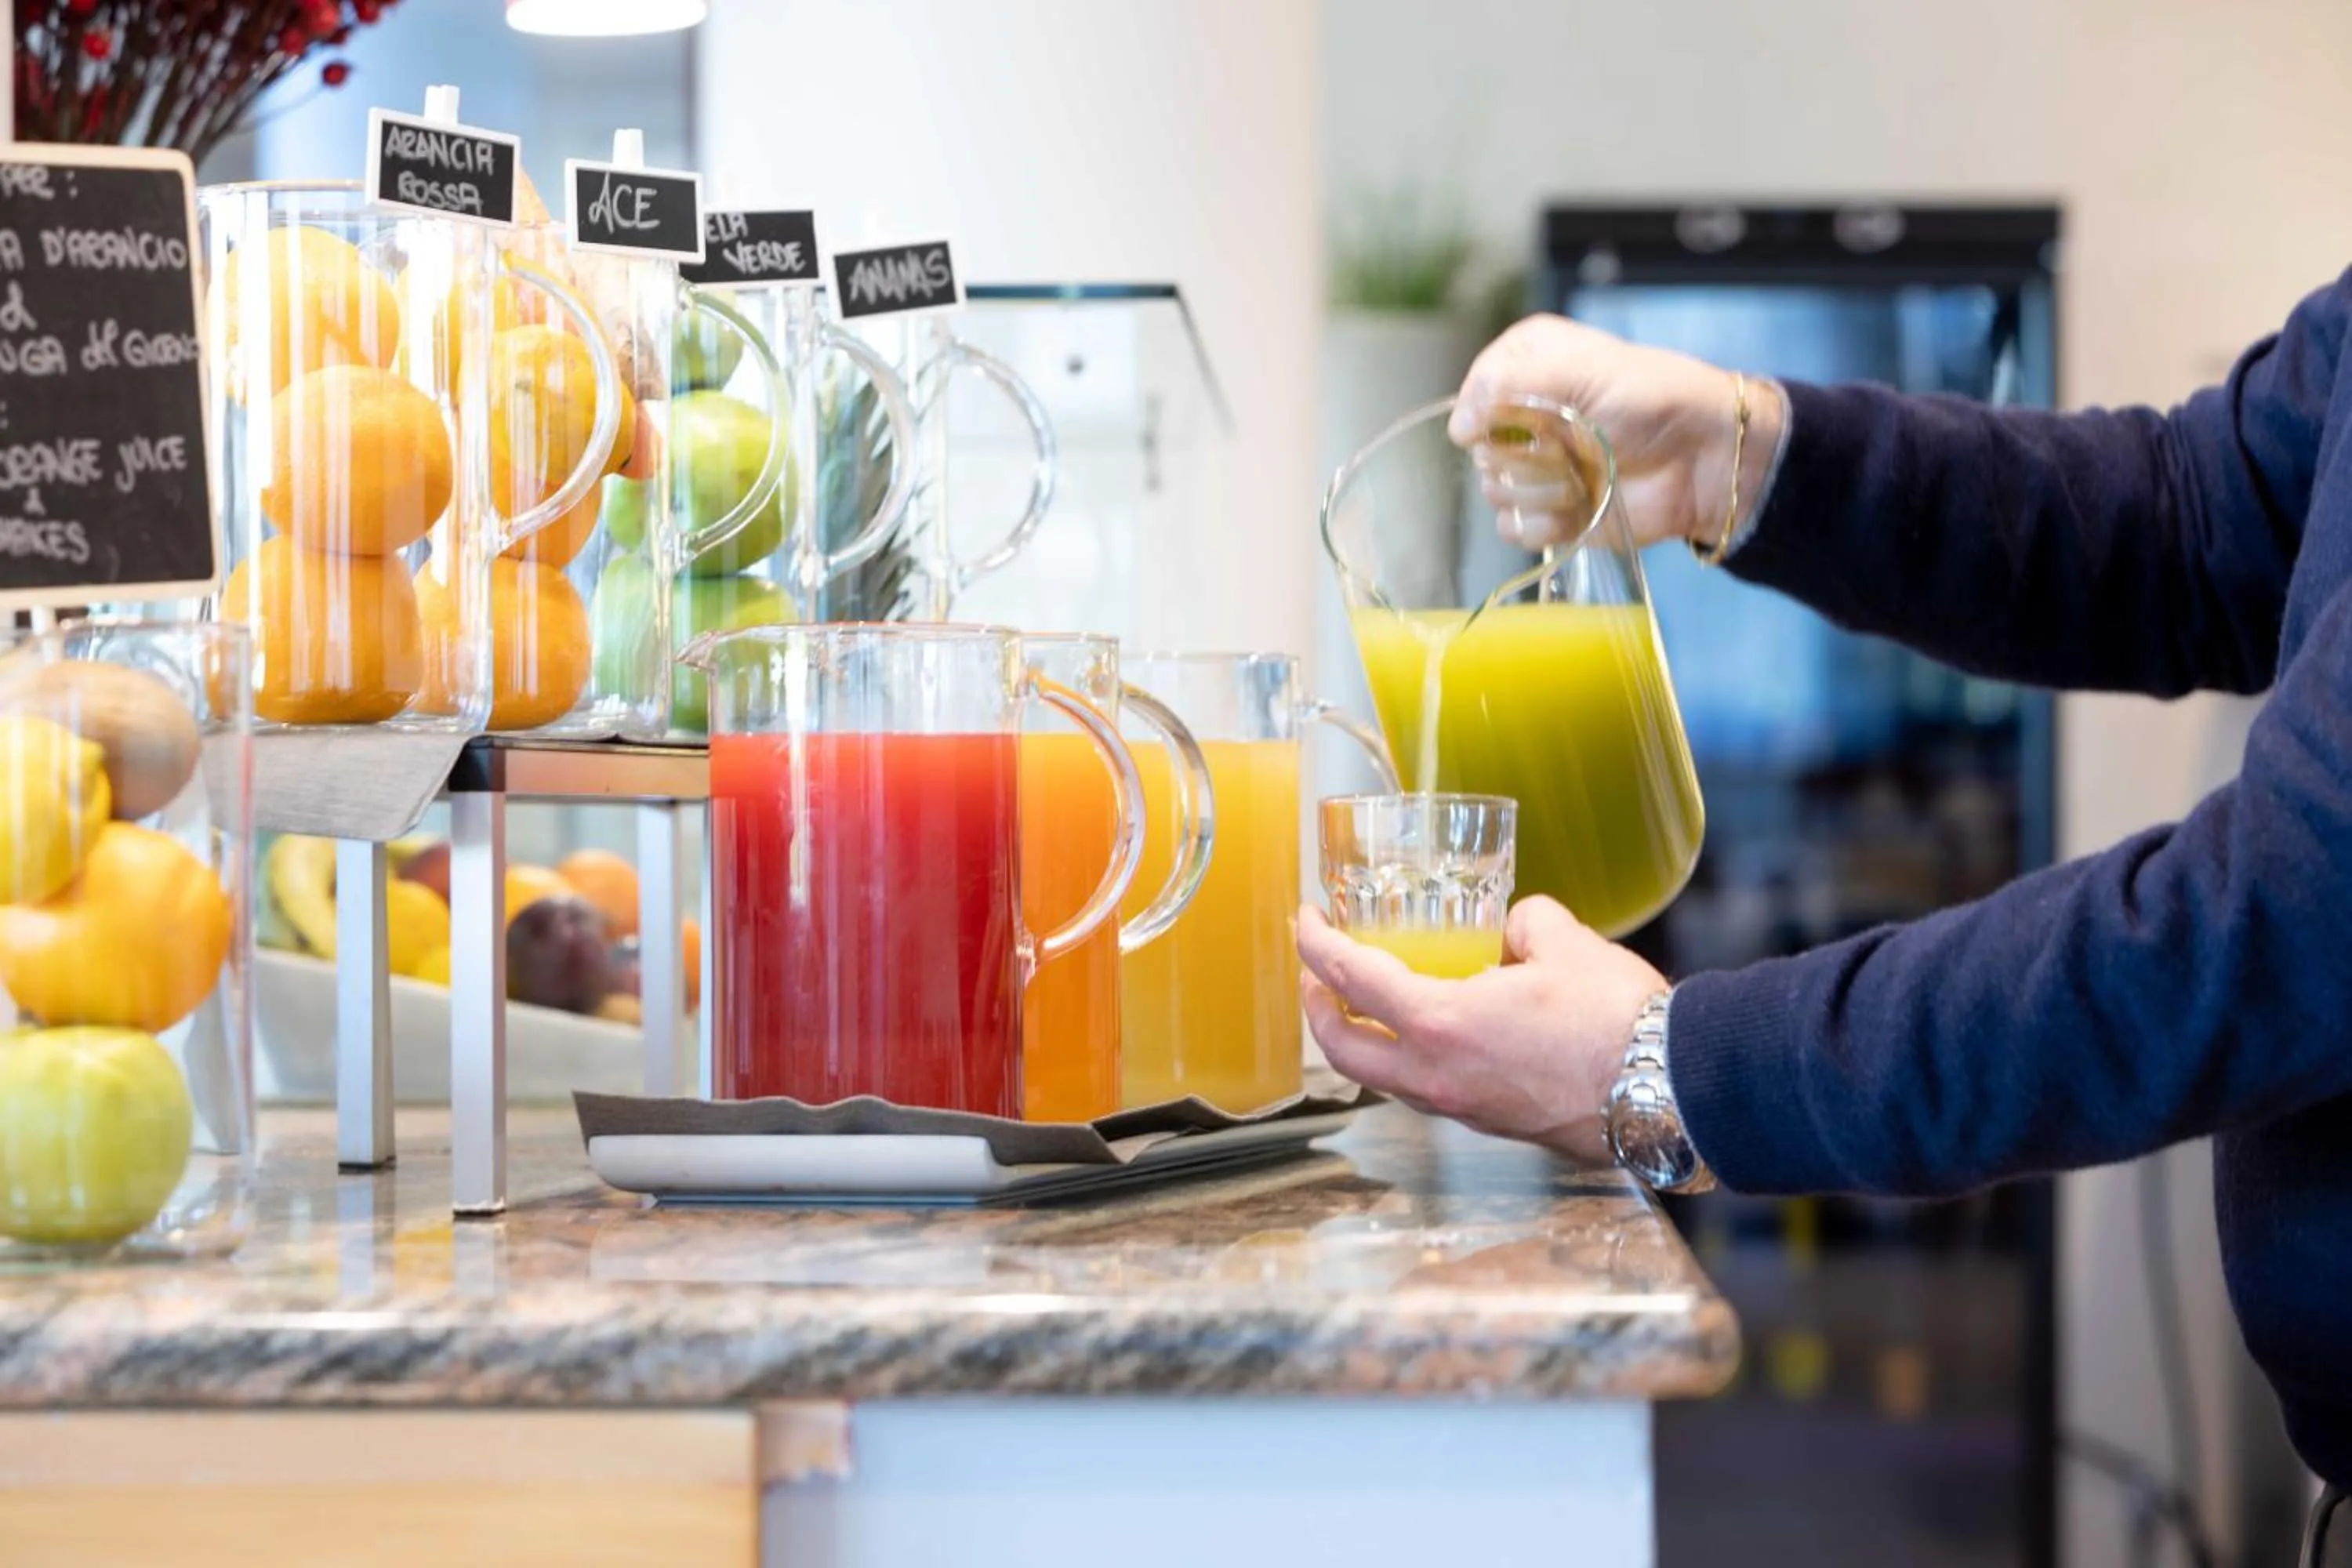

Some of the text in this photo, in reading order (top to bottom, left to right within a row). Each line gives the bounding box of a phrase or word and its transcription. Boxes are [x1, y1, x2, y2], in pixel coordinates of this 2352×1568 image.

[384, 124, 495, 176] ARANCIA
[397, 169, 484, 216] ROSSA
[587, 171, 661, 235] ACE
[705, 213, 750, 244] ELA
[722, 239, 808, 275] VERDE
[848, 248, 951, 306] ANANAS
[115, 434, 187, 495] JUICE
